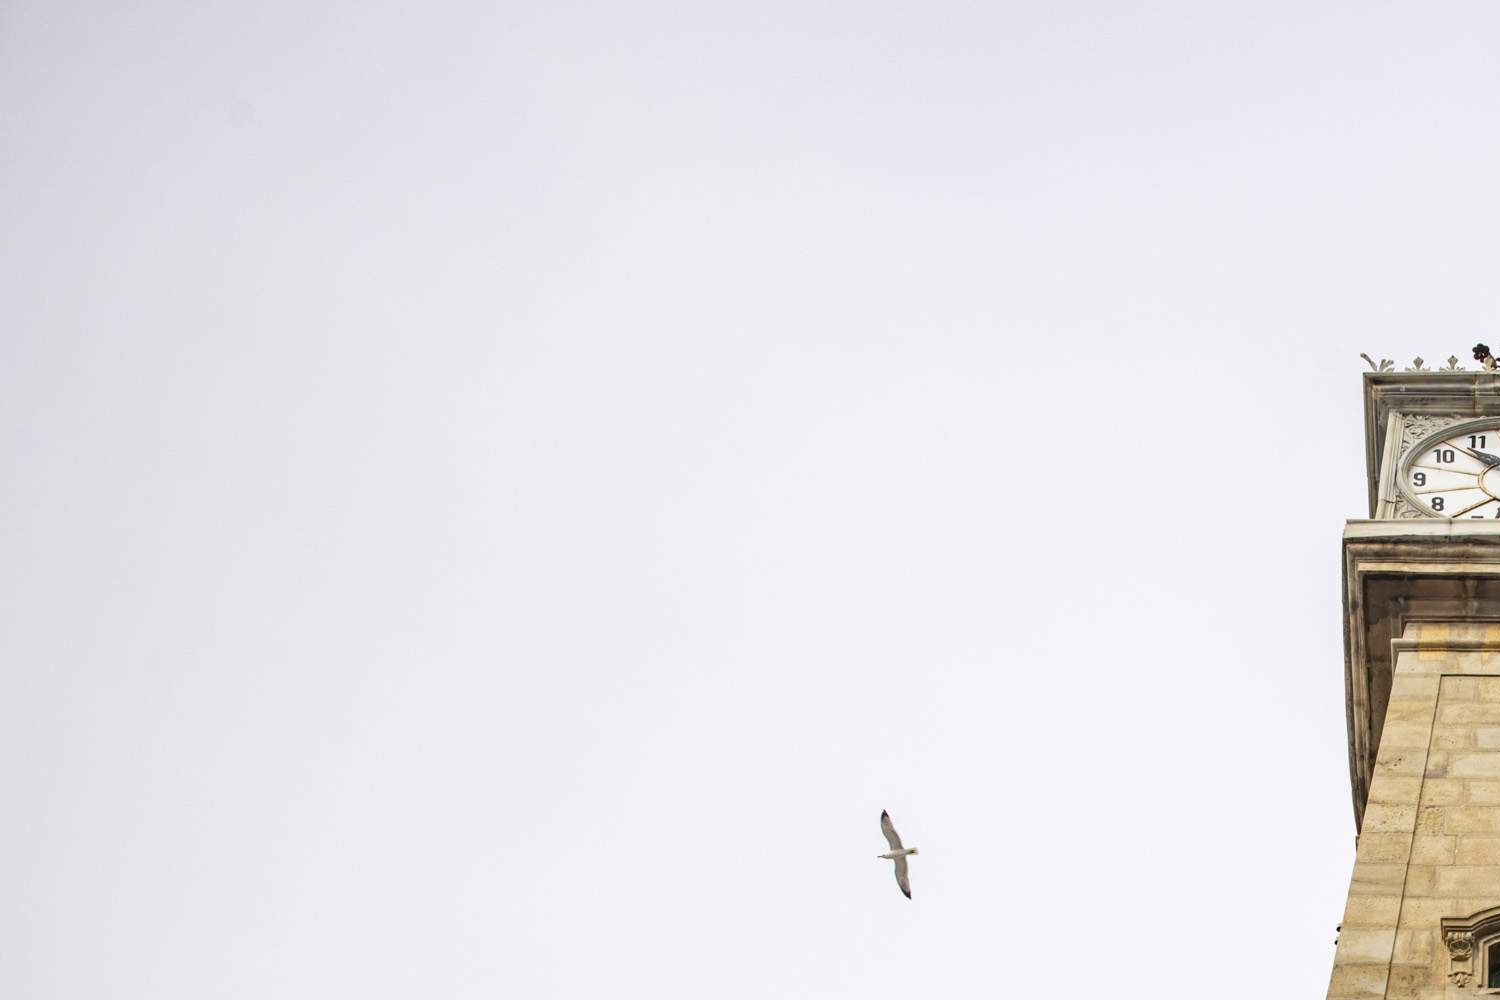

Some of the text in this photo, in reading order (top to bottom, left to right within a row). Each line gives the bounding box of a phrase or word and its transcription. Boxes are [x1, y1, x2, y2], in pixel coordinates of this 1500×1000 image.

[1468, 435, 1486, 449] 11
[1433, 449, 1455, 463] 10
[1413, 472, 1426, 487] 9
[1431, 497, 1444, 511] 8
